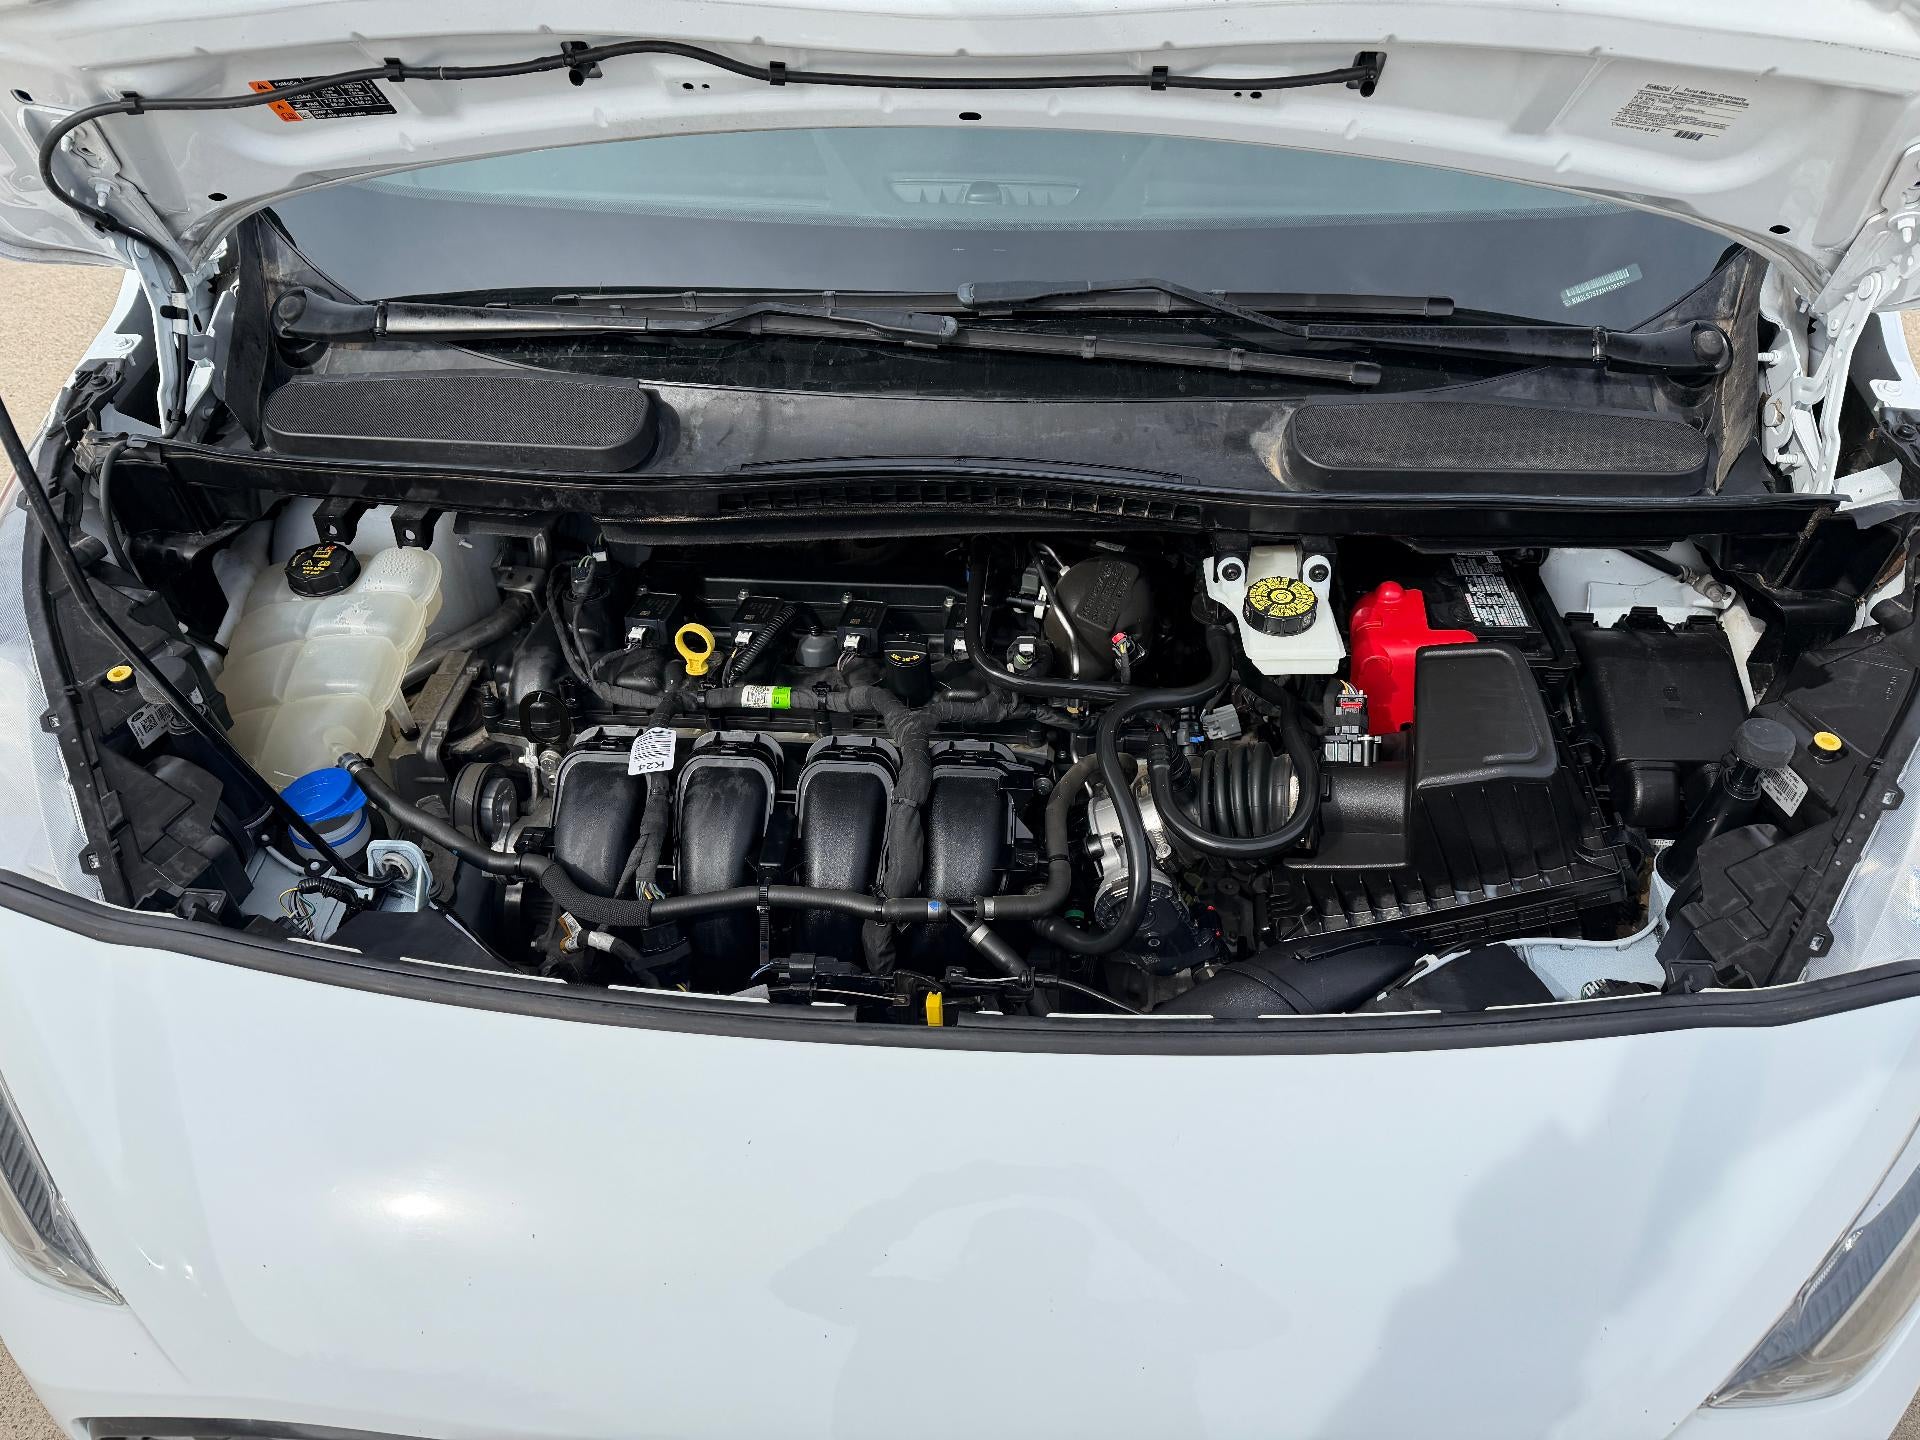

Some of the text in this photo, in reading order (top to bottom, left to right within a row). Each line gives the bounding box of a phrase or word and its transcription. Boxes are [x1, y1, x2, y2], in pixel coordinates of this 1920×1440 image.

[1645, 83, 1671, 92] FoMoCo
[1718, 93, 1747, 102] Company
[638, 760, 665, 771] K24
